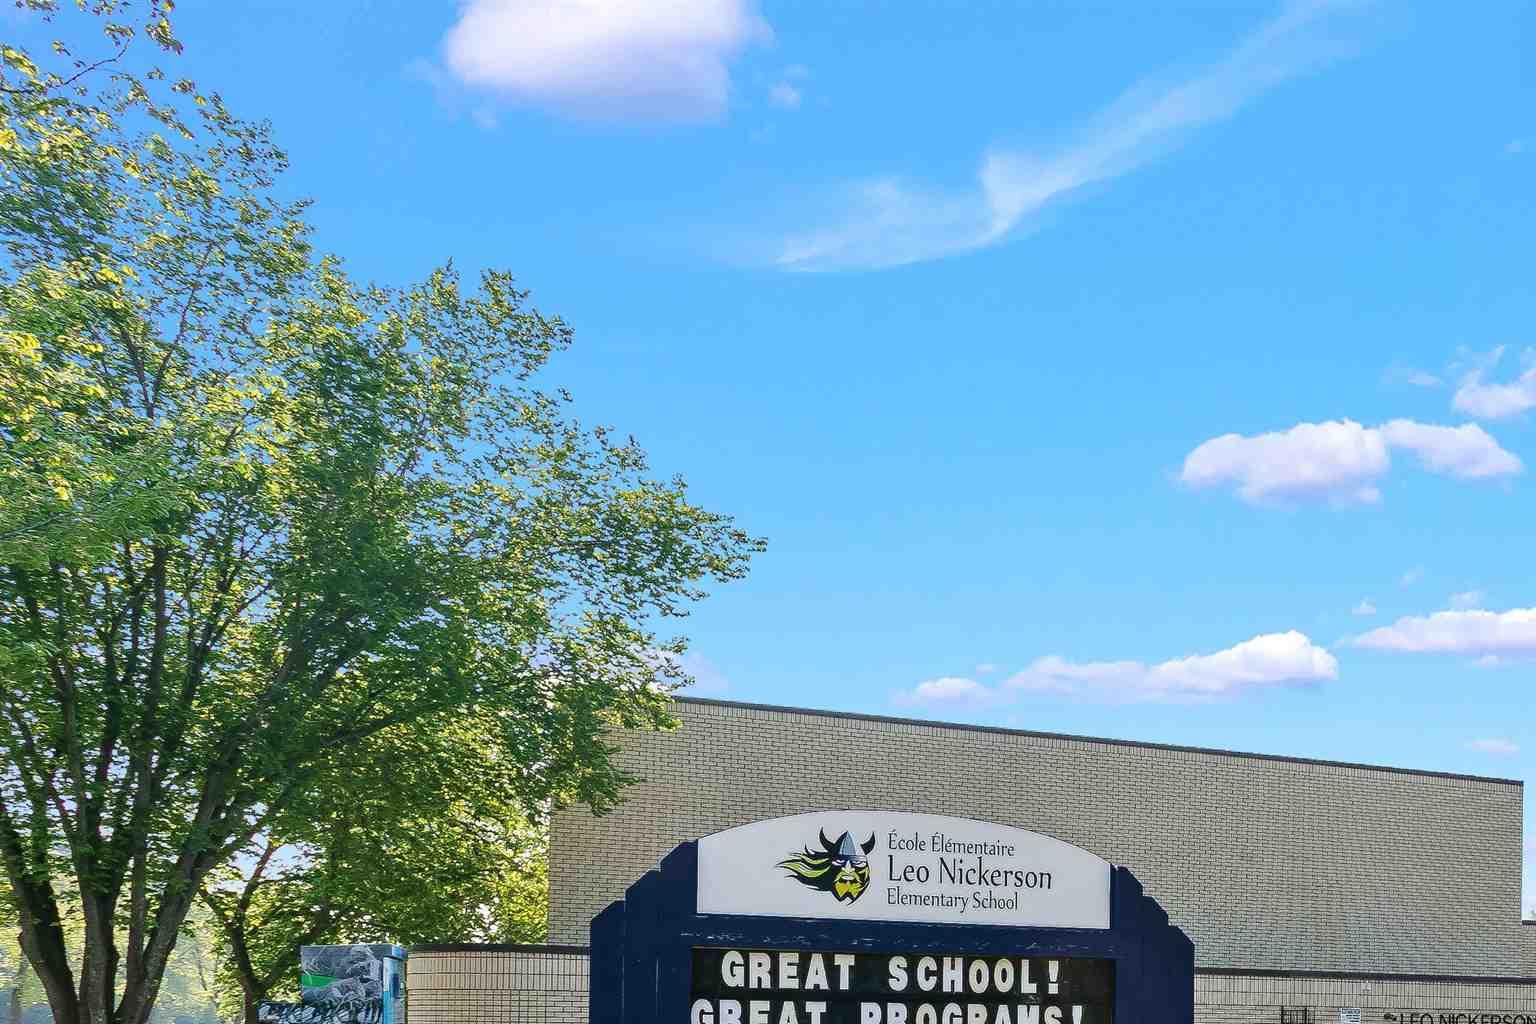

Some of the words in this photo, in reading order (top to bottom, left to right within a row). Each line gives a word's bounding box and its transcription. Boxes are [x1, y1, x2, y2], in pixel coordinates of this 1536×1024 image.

[888, 830, 926, 851] École
[931, 832, 1015, 856] Élémentaire
[888, 855, 930, 883] Leo
[939, 856, 1051, 889] Nickerson
[887, 886, 969, 913] Elementary
[972, 890, 1018, 910] School
[721, 950, 855, 990] GREAT
[888, 956, 1061, 994] SCHOOL!
